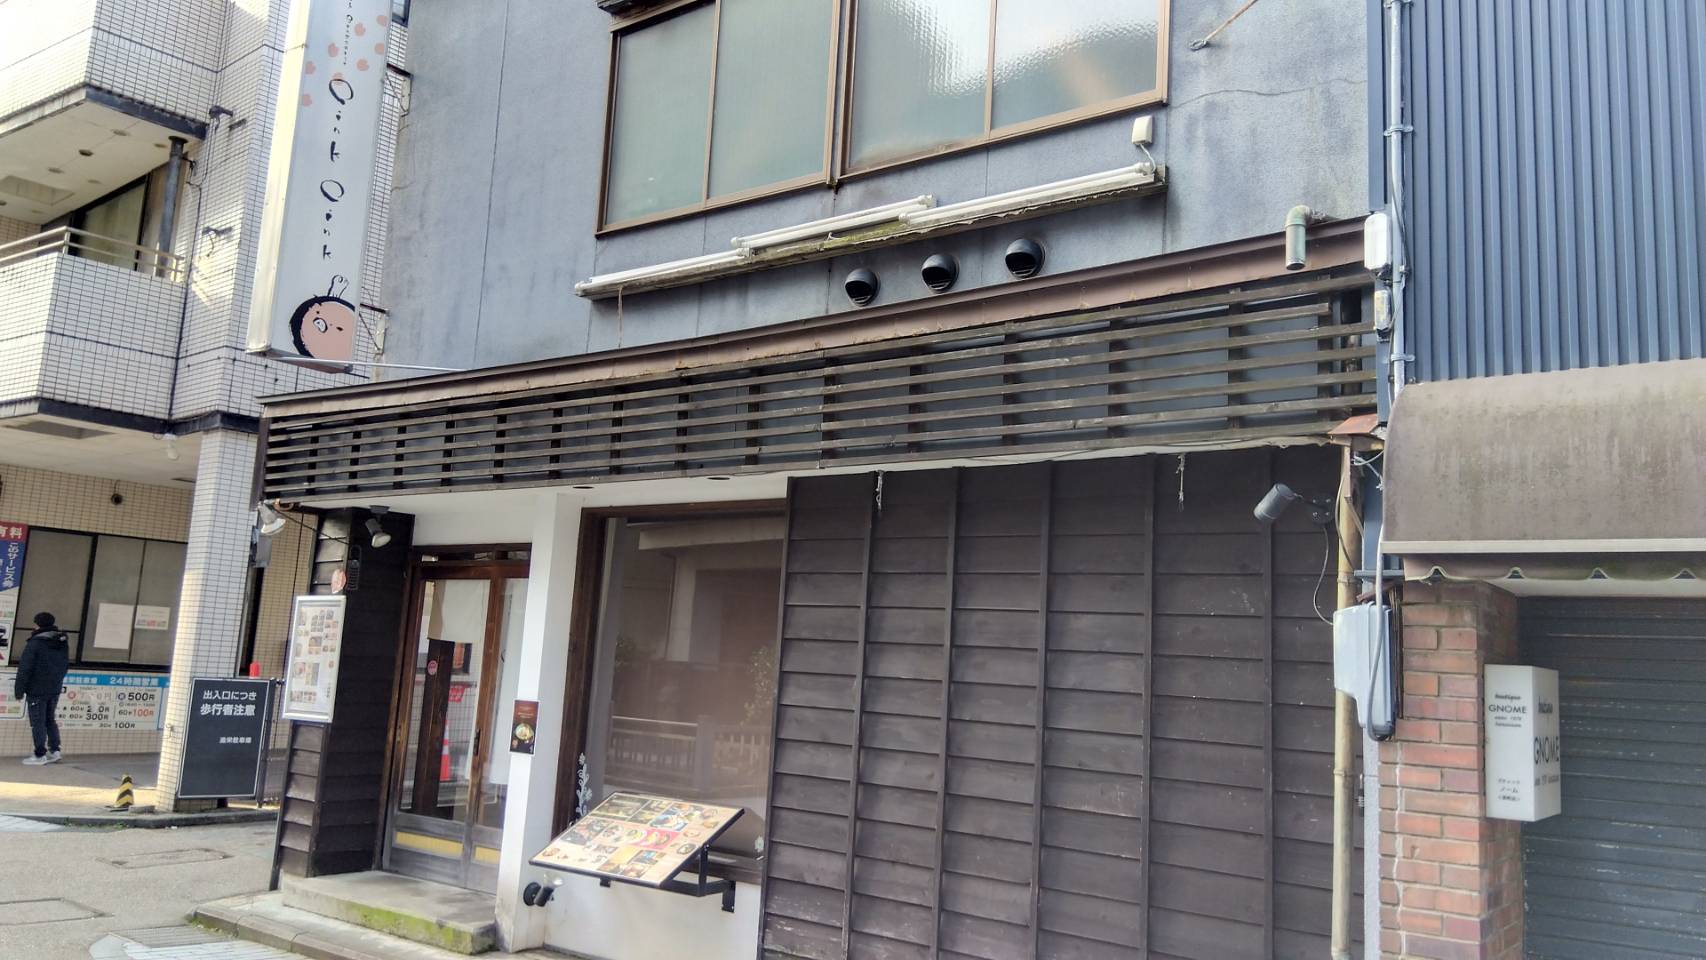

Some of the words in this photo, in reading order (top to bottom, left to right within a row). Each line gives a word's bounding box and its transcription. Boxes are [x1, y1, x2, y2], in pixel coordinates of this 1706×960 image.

[203, 690, 257, 701] 出入口につき
[200, 703, 256, 717] 歩行者注意
[1488, 704, 1527, 714] GNOME
